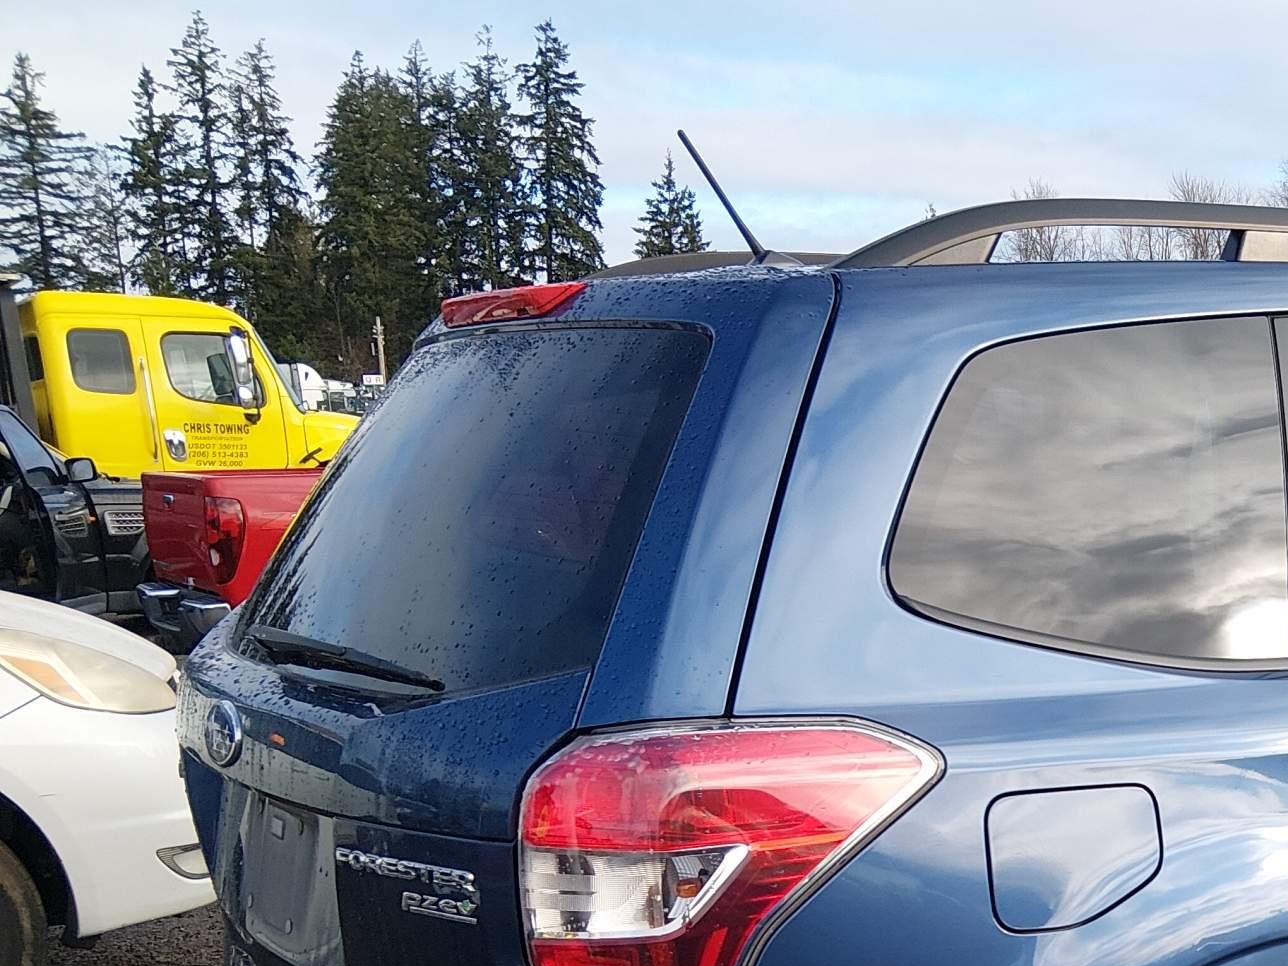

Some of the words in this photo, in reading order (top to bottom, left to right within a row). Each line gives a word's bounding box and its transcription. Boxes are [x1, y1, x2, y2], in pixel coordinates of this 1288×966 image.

[183, 422, 212, 434] CHRIS
[213, 423, 250, 435] TOWING
[188, 451, 209, 459] (206)
[212, 451, 249, 459] 513-4383
[335, 846, 477, 892] FORESTER
